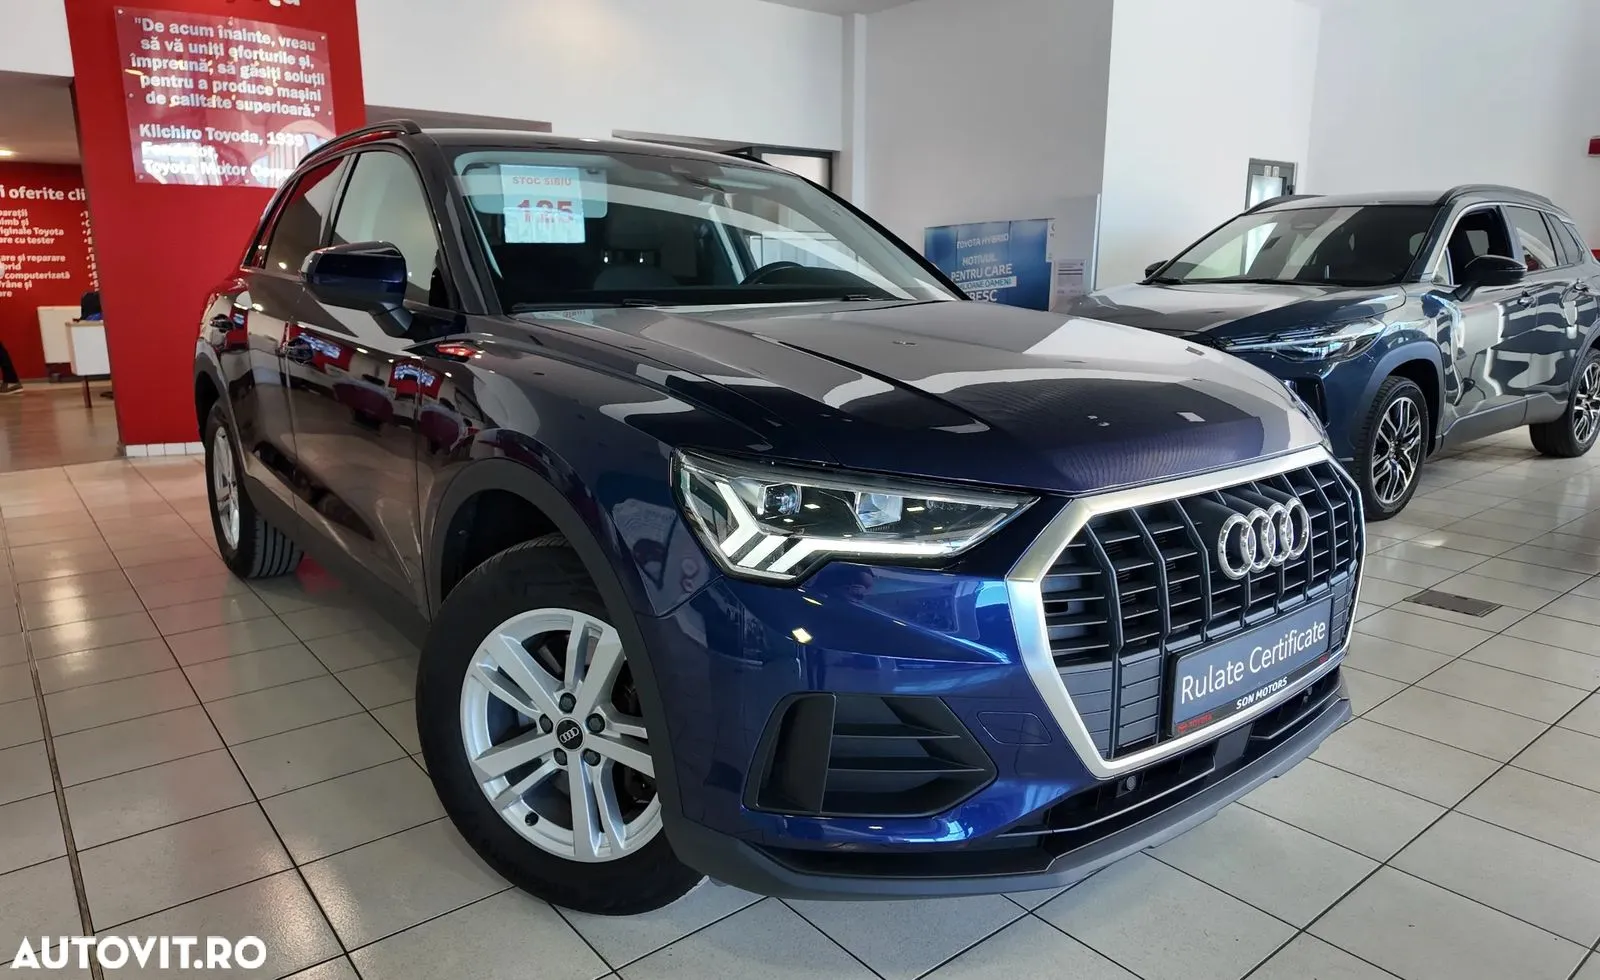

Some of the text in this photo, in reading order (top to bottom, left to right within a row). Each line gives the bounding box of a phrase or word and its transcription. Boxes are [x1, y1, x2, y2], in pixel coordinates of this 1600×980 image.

[169, 23, 214, 37] acum
[217, 25, 276, 48] înainte,
[278, 34, 316, 52] vreau
[140, 35, 161, 51] să
[164, 37, 184, 53] vă
[228, 44, 296, 65] eforturile
[217, 59, 236, 75] să
[139, 74, 194, 89] pentru
[198, 79, 208, 90] a
[212, 80, 274, 96] produce
[145, 90, 167, 105] de
[170, 93, 232, 109] calitate
[139, 123, 202, 140] Kiichiro
[204, 127, 263, 146] Toyoda,
[200, 161, 247, 177] Motor
[512, 176, 572, 186] STOC SIBIU
[8, 185, 65, 200] oferite
[26, 236, 55, 244] tester
[32, 227, 65, 237] Toyota
[957, 238, 981, 249] TOYOTA
[26, 255, 66, 264] reparare
[4, 271, 71, 281] computerizată
[951, 263, 1013, 281] PENTRU CARE
[966, 289, 998, 302] BESC
[1181, 620, 1327, 705] Rulate Certificate
[1236, 676, 1288, 710] SON MOTORS
